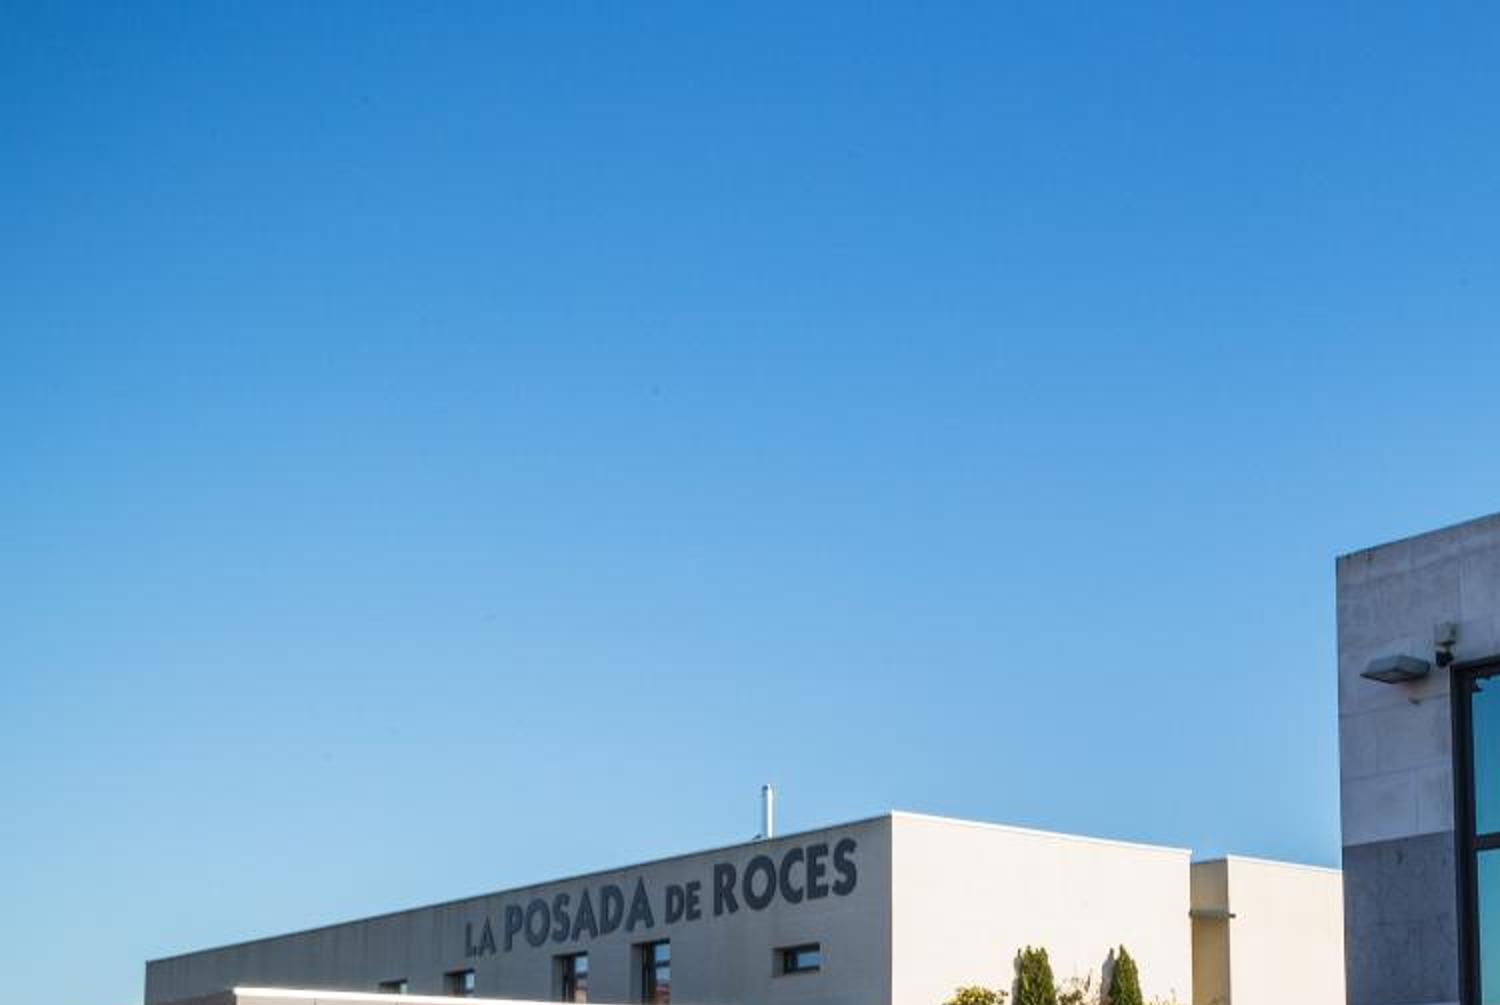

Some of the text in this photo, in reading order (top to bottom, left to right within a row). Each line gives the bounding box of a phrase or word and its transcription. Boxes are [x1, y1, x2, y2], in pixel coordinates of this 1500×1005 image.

[464, 837, 859, 959] LA POSADA DE ROCES
